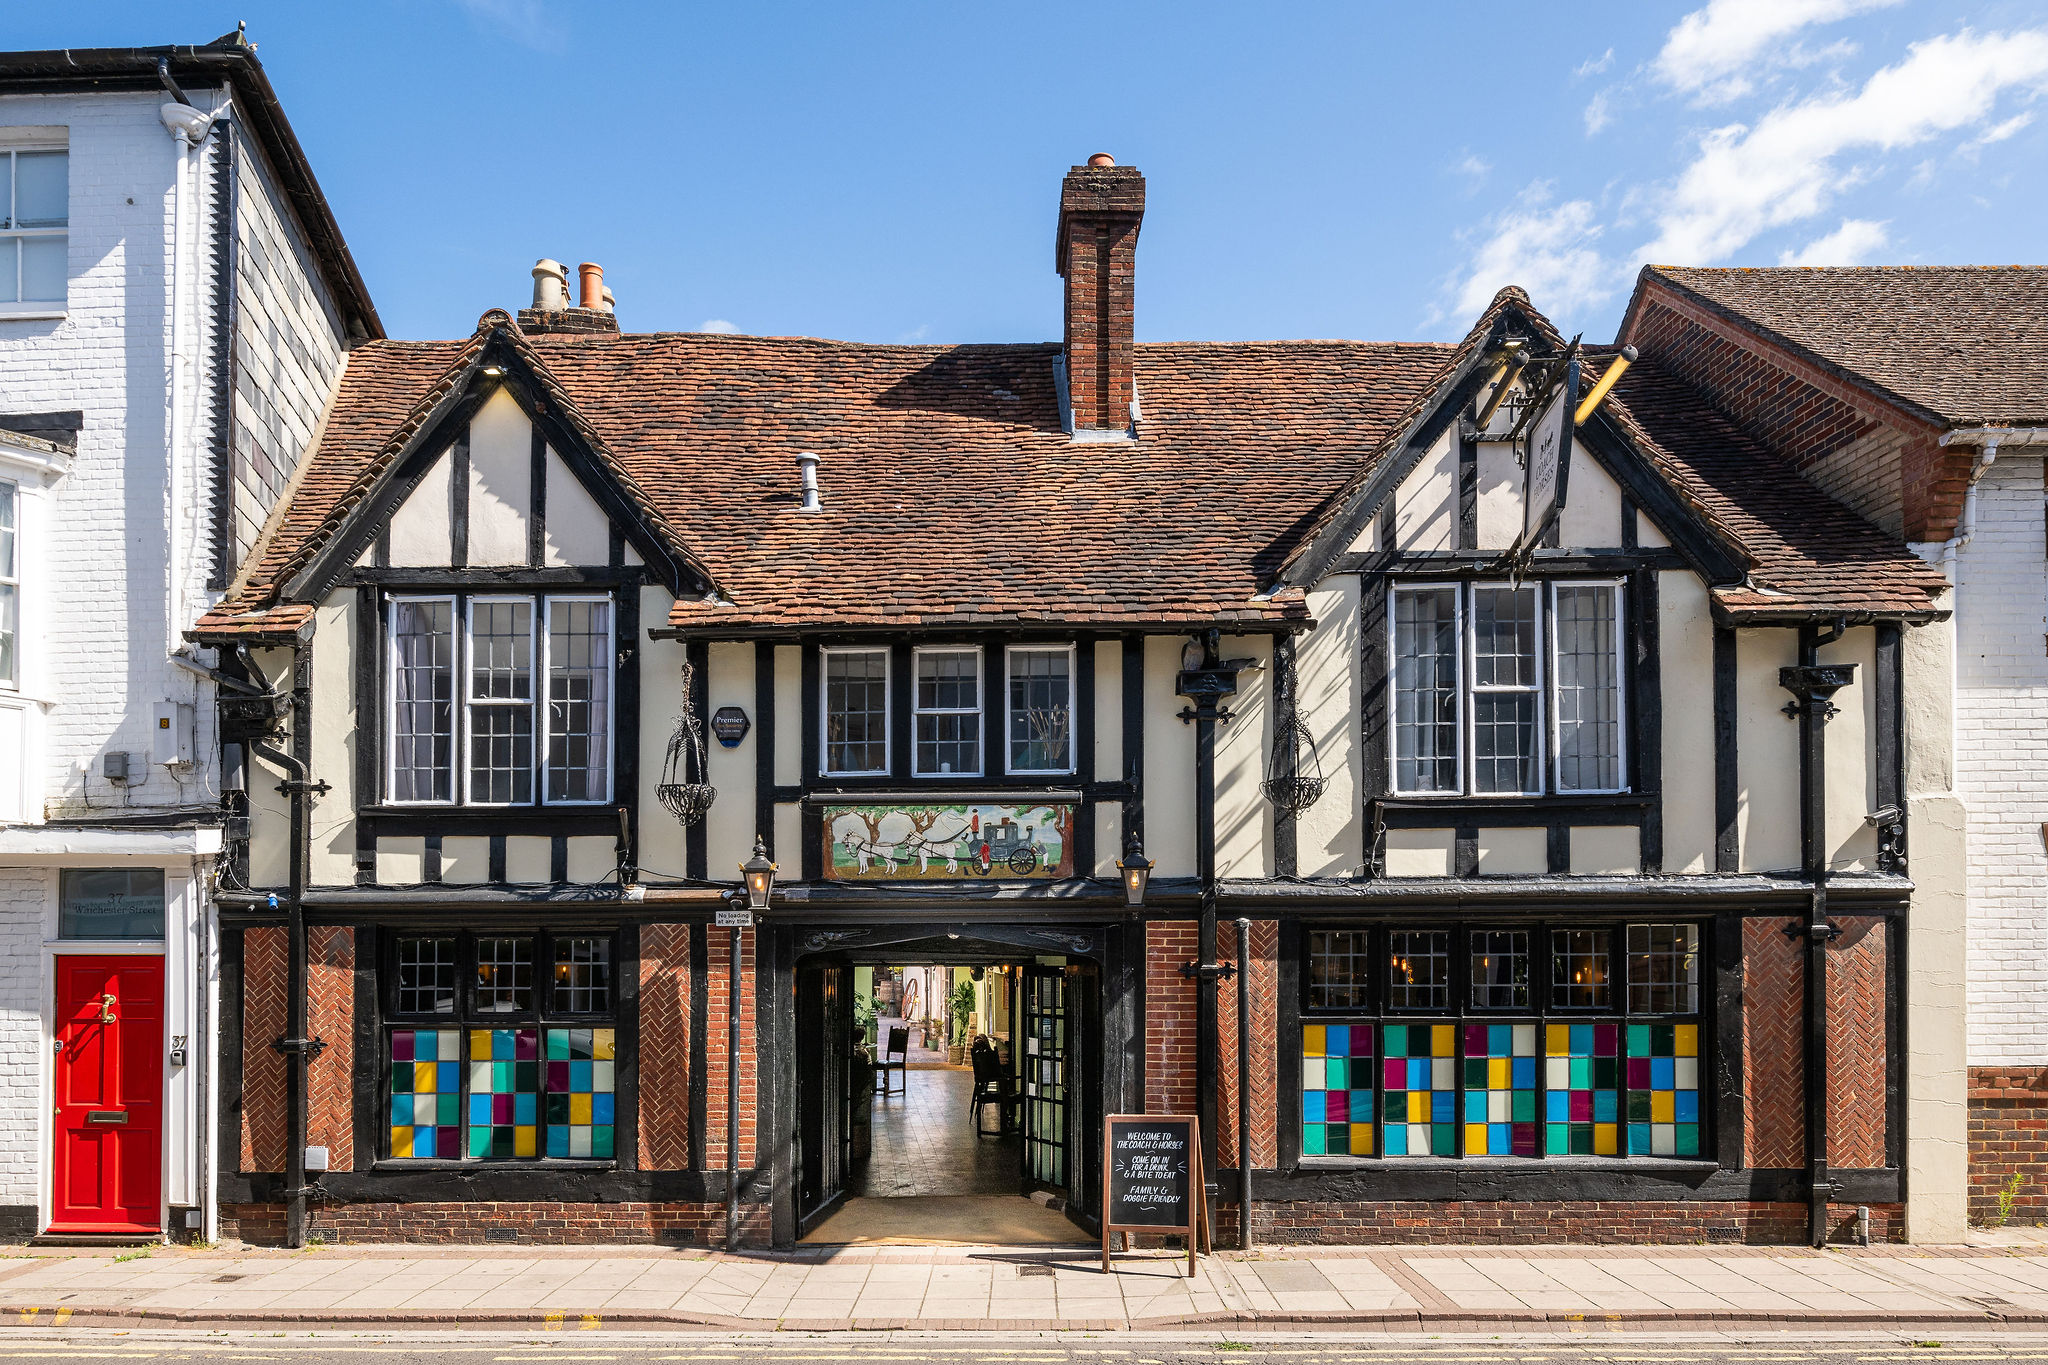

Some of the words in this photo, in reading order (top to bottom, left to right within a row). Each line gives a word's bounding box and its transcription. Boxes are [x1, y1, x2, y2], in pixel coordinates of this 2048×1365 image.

[107, 893, 124, 903] 37
[75, 905, 127, 914] Winchester
[129, 905, 156, 914] Street
[172, 1036, 188, 1048] 37
[1127, 1132, 1161, 1140] WELCOME
[1162, 1132, 1172, 1140] TO
[1116, 1140, 1129, 1149] THE
[1129, 1140, 1151, 1149] COACH
[1151, 1140, 1158, 1149] &
[1158, 1140, 1184, 1150] HORSES
[1131, 1155, 1150, 1164] COME
[1150, 1155, 1160, 1164] ON
[1161, 1155, 1170, 1164] IN
[1131, 1163, 1143, 1171] FOR
[1149, 1163, 1169, 1171] DRINK
[1123, 1169, 1130, 1179] &
[1130, 1170, 1135, 1178] A
[1137, 1171, 1154, 1179] BITE
[1154, 1171, 1163, 1179] TO
[1163, 1171, 1177, 1179] EAT
[1129, 1185, 1159, 1194] FAMILY
[1160, 1186, 1169, 1195] &
[1122, 1194, 1148, 1203] DOGGIE
[1148, 1194, 1181, 1204] FRIENDLY
